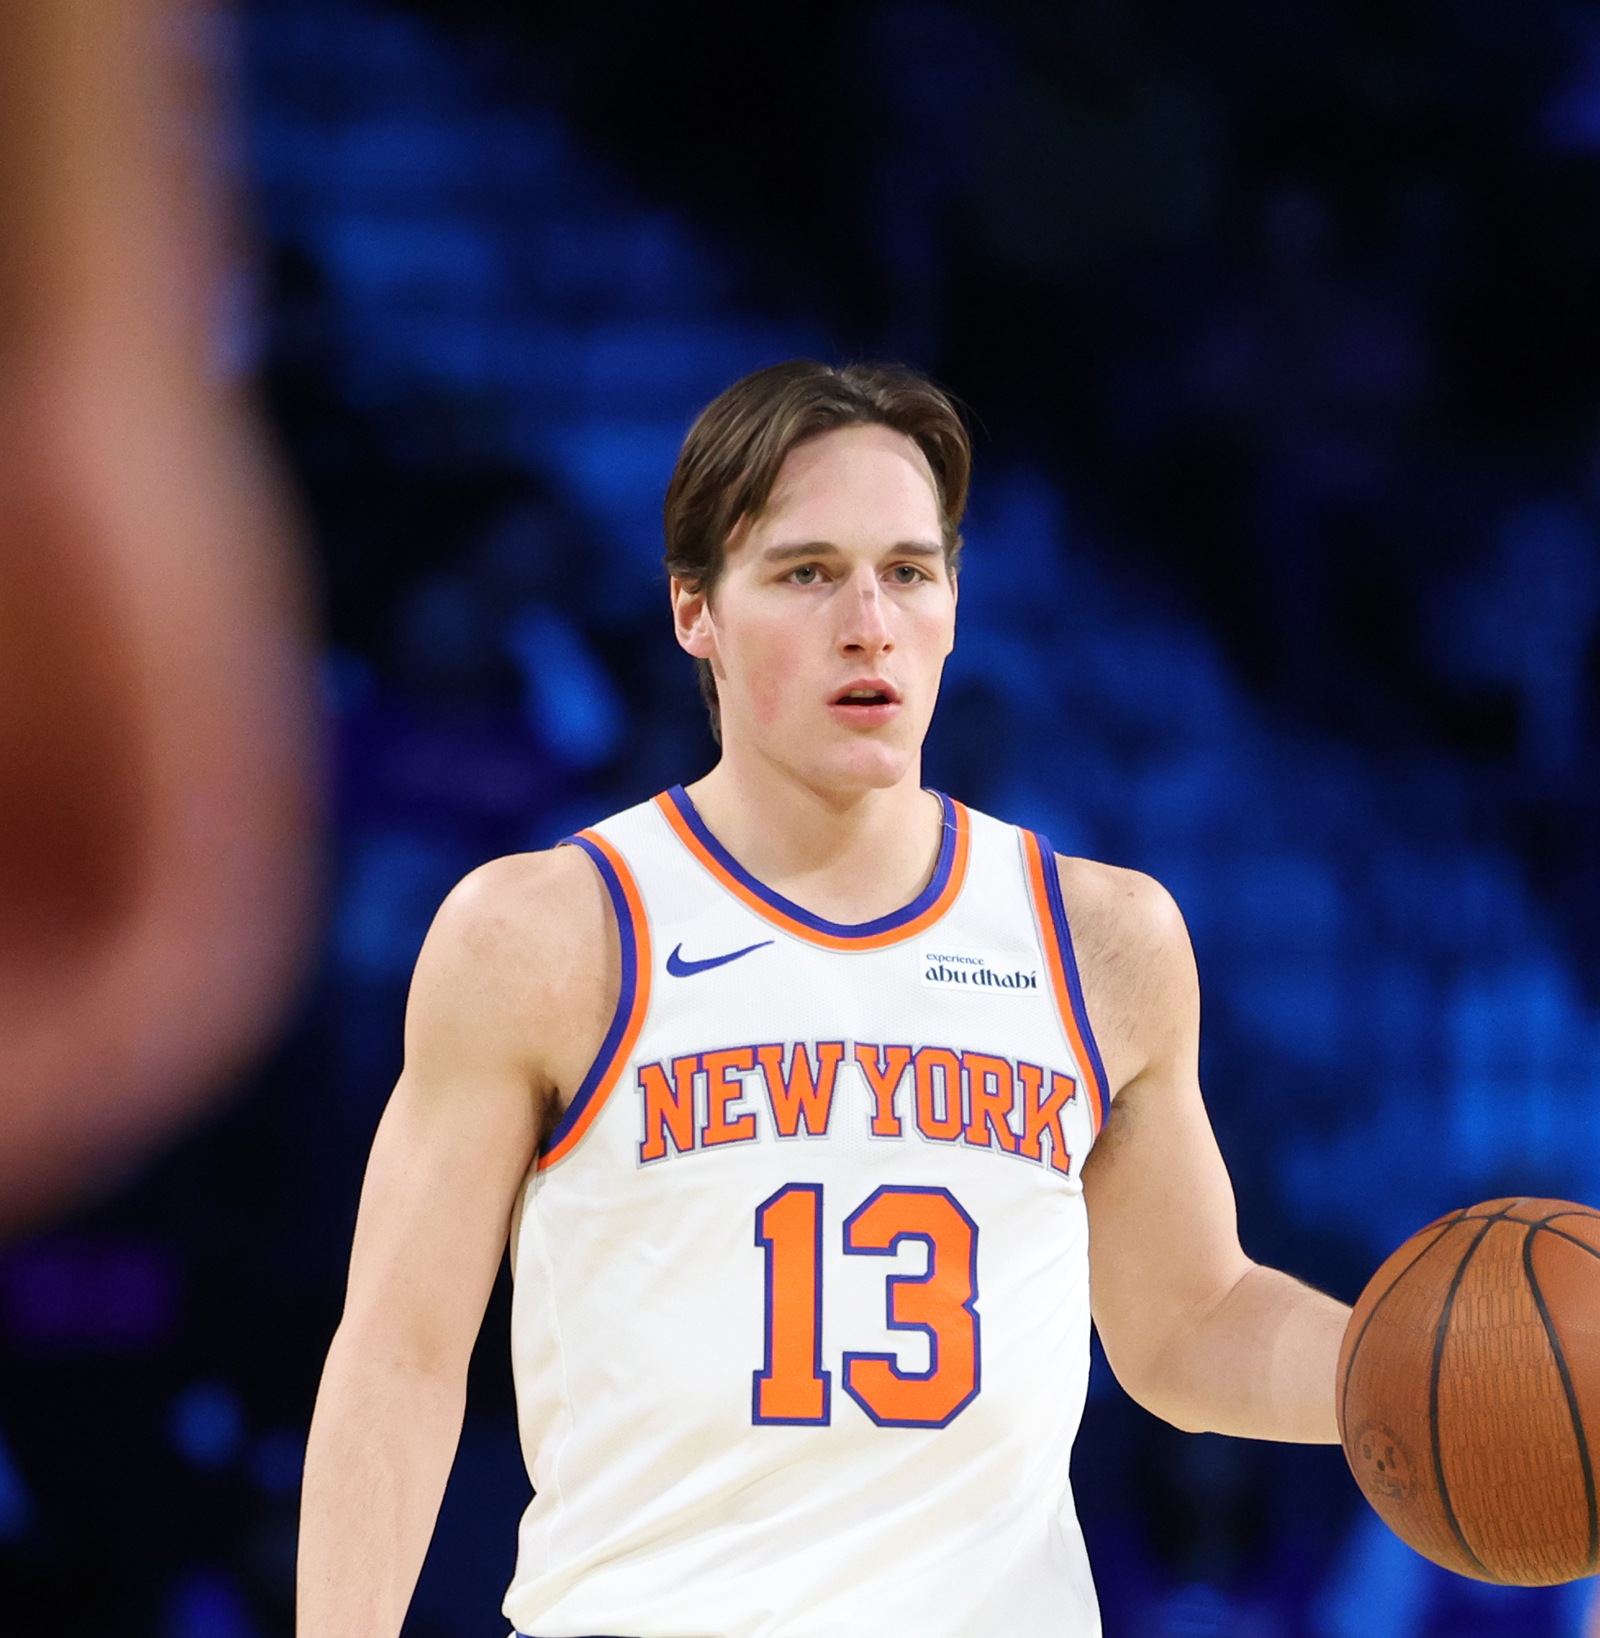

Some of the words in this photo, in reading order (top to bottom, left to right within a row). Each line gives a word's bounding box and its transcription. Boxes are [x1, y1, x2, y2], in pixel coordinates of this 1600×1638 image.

[925, 952, 985, 965] experience
[925, 964, 968, 985] abu
[636, 1039, 846, 1165] NEW
[853, 1040, 1078, 1178] YORK
[752, 1182, 982, 1430] 13
